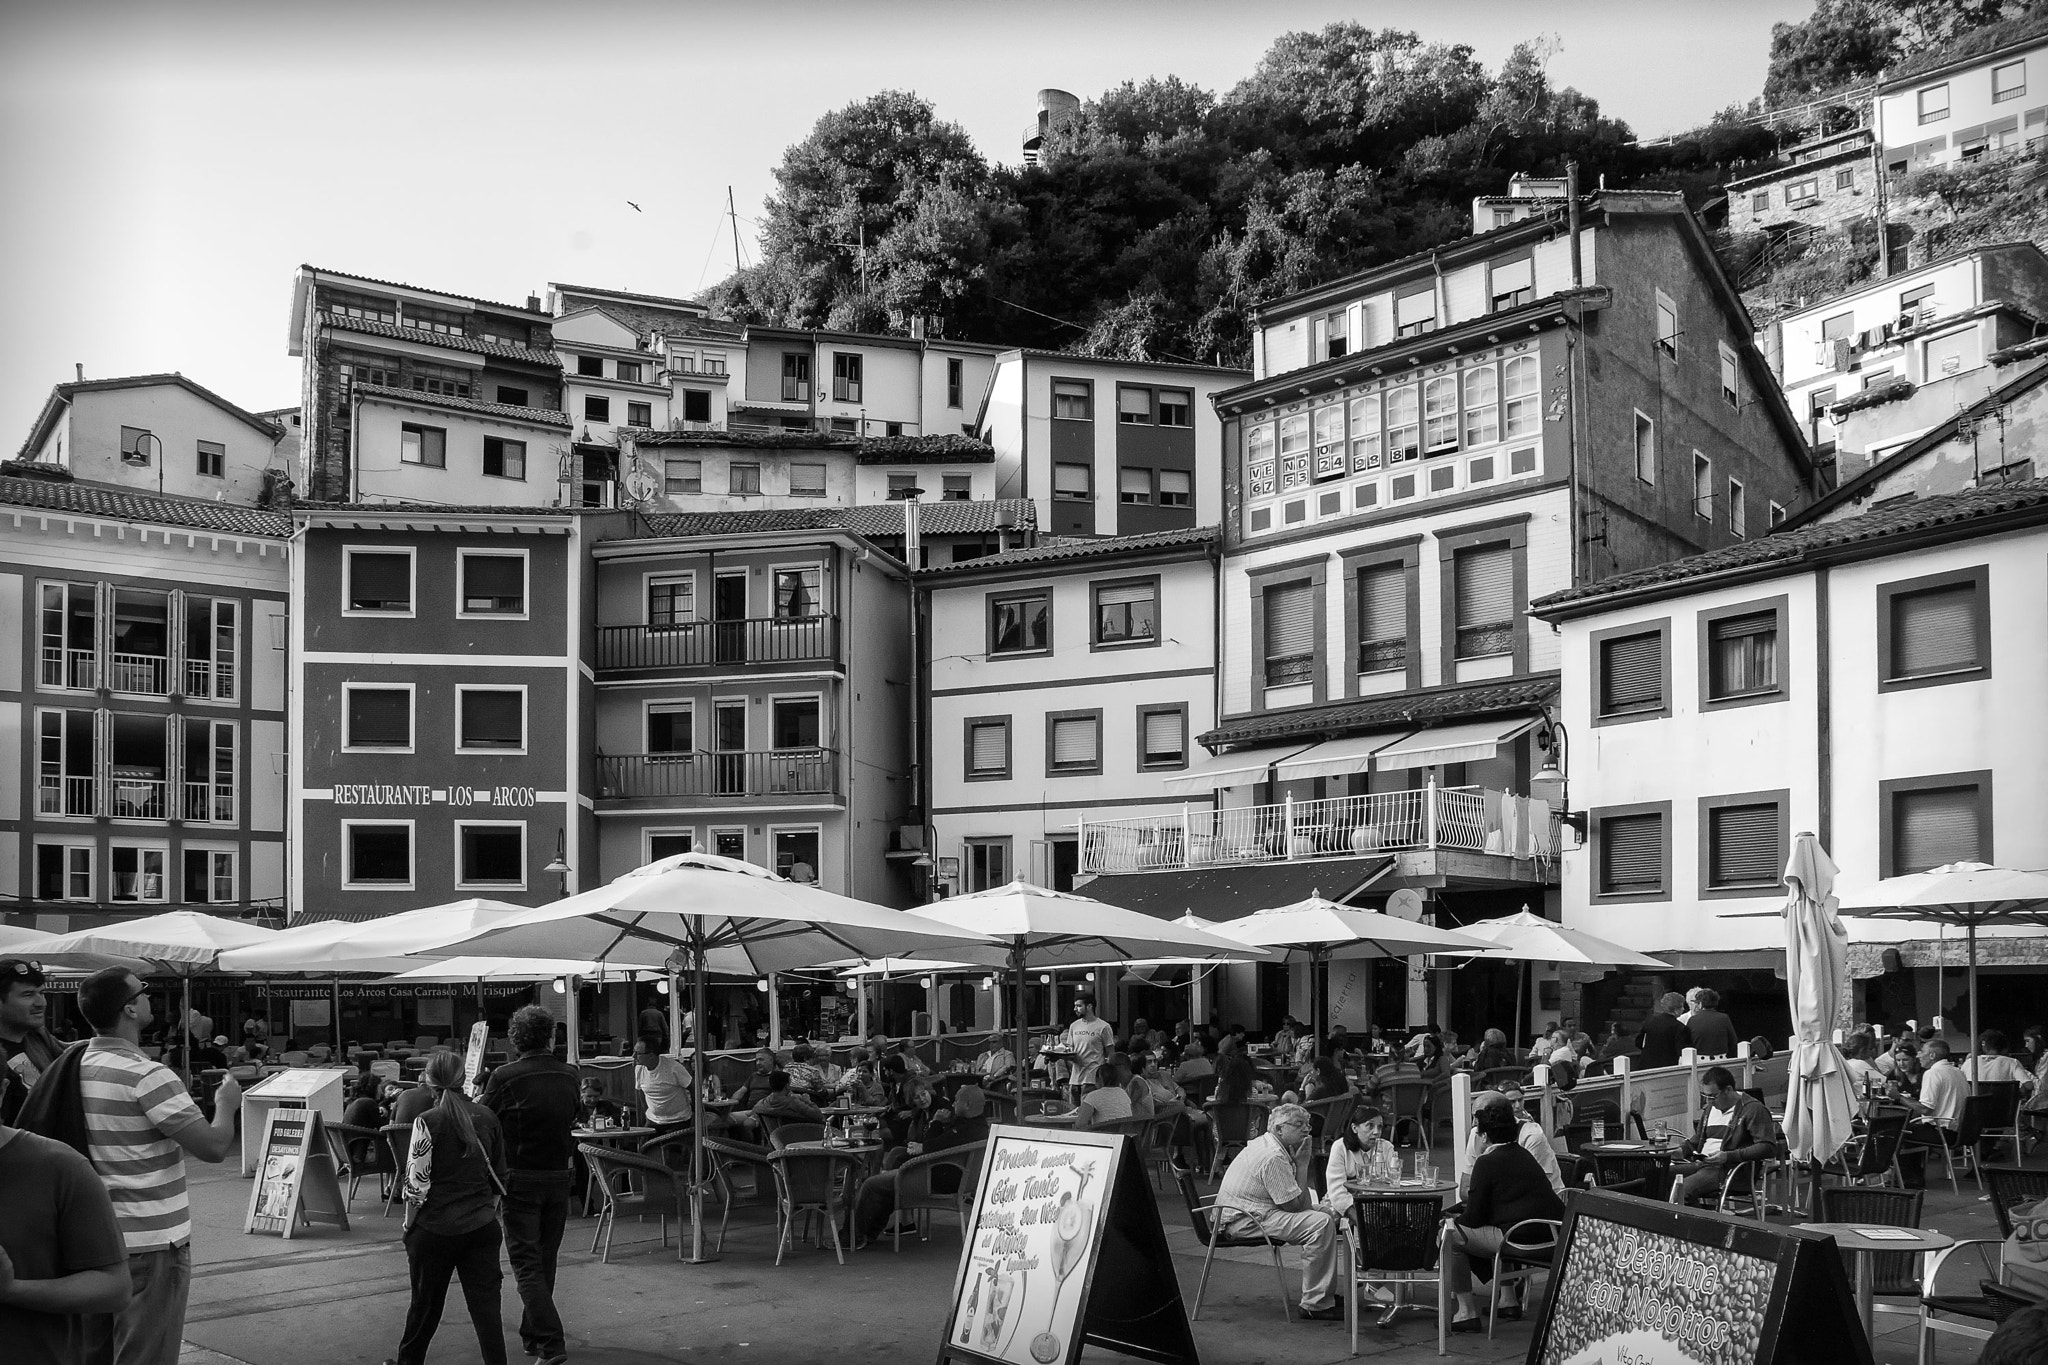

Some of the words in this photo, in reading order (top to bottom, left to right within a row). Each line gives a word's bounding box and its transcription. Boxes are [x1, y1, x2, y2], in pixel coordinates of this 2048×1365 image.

[334, 784, 431, 805] RESTAURANTE
[448, 786, 473, 806] LOS
[492, 786, 535, 807] ARCOS
[357, 985, 386, 997] Arcos
[389, 985, 413, 997] Casa
[272, 1145, 299, 1155] DESAYUNOS
[995, 1145, 1039, 1171] Prueba
[1041, 1151, 1076, 1169] nuestro
[1022, 1170, 1060, 1202] Tonic
[1615, 1233, 1720, 1296] Desayuna
[1585, 1279, 1624, 1314] con
[1624, 1283, 1729, 1351] Nosotros
